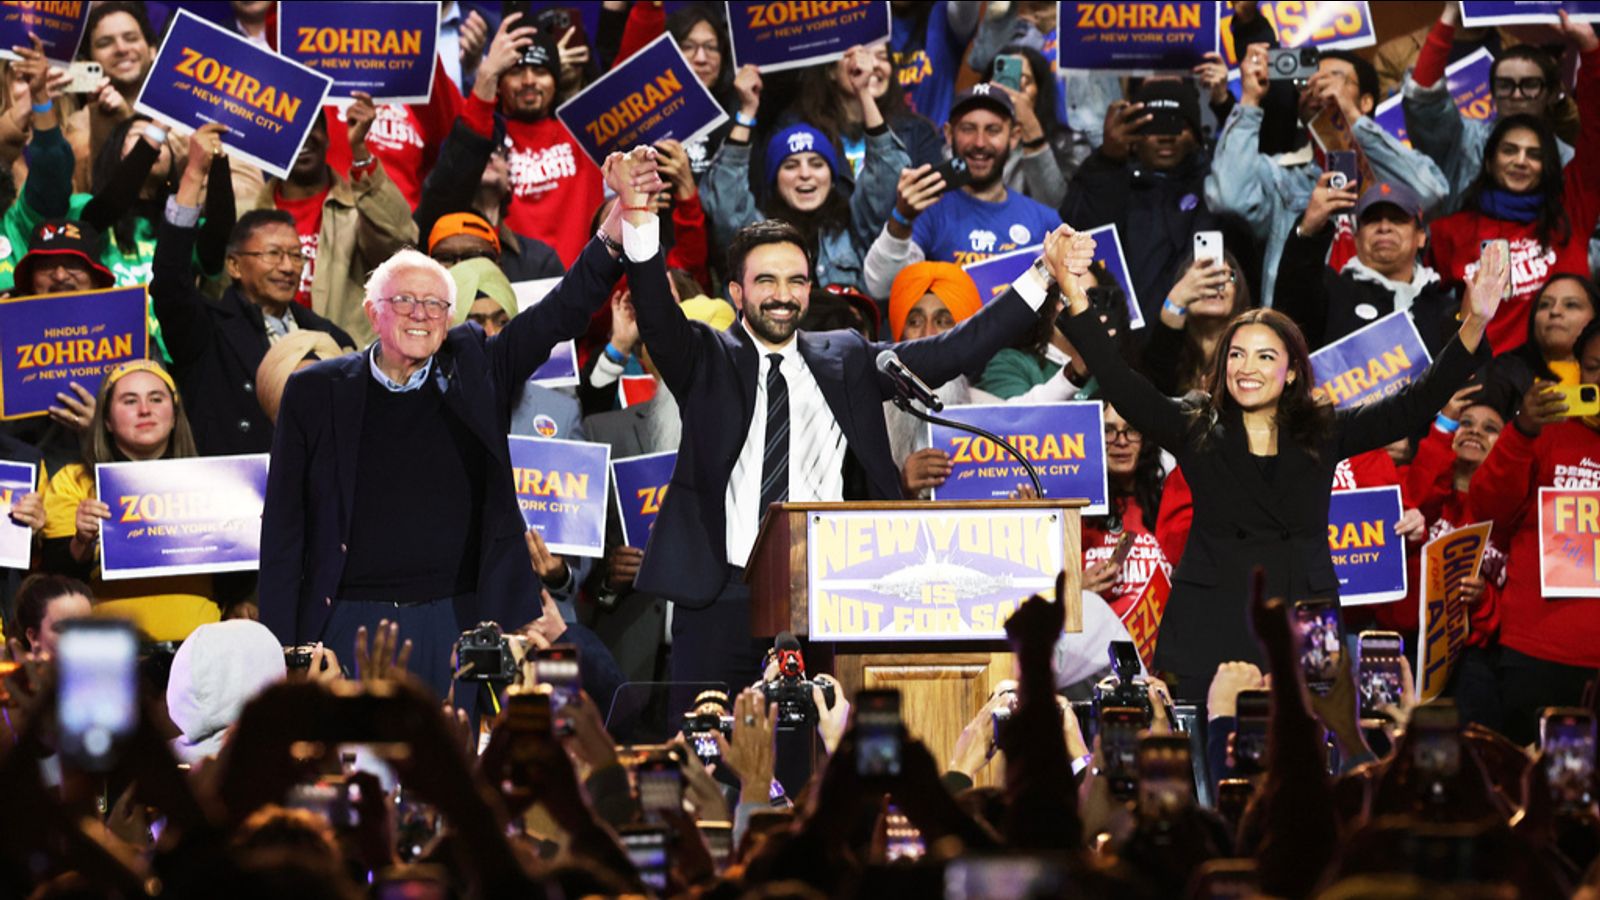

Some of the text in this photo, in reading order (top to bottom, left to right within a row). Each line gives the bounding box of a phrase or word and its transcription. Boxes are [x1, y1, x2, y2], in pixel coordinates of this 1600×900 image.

[774, 25, 804, 38] NEW
[806, 18, 838, 32] YORK
[841, 10, 868, 25] CITY
[1076, 3, 1201, 29] ZOHRAN
[297, 26, 423, 55] ZOHRAN
[1100, 33, 1128, 42] NEW
[1131, 33, 1163, 43] YORK
[1166, 32, 1195, 42] CITY
[321, 58, 350, 69] NEW
[353, 59, 386, 70] YORK
[388, 60, 415, 70] CITY
[174, 47, 302, 123] ZOHRAN
[192, 86, 221, 106] NEW
[223, 99, 253, 121] YORK
[255, 115, 284, 134] CITY
[585, 68, 683, 146] ZOHRAN
[617, 129, 639, 147] NEW
[639, 114, 664, 133] YORK
[662, 97, 686, 117] CITY
[44, 325, 88, 338] HINDUS
[16, 333, 133, 369] ZOHRAN
[39, 369, 68, 379] NEW
[70, 366, 101, 377] YORK
[1384, 375, 1412, 395] CITY
[950, 433, 1086, 463] ZOHRAN
[978, 466, 1009, 478] NEW
[1012, 465, 1047, 477] YOK
[1049, 464, 1081, 476] CITY
[517, 499, 581, 514] ORK CITY
[147, 525, 177, 537] NEW
[817, 516, 1054, 580] NEW YORK
[1350, 552, 1380, 564] CITY
[921, 583, 956, 605] IS
[819, 590, 884, 634] NOT
[894, 606, 960, 633] FOR
[1424, 601, 1446, 691] ALL
